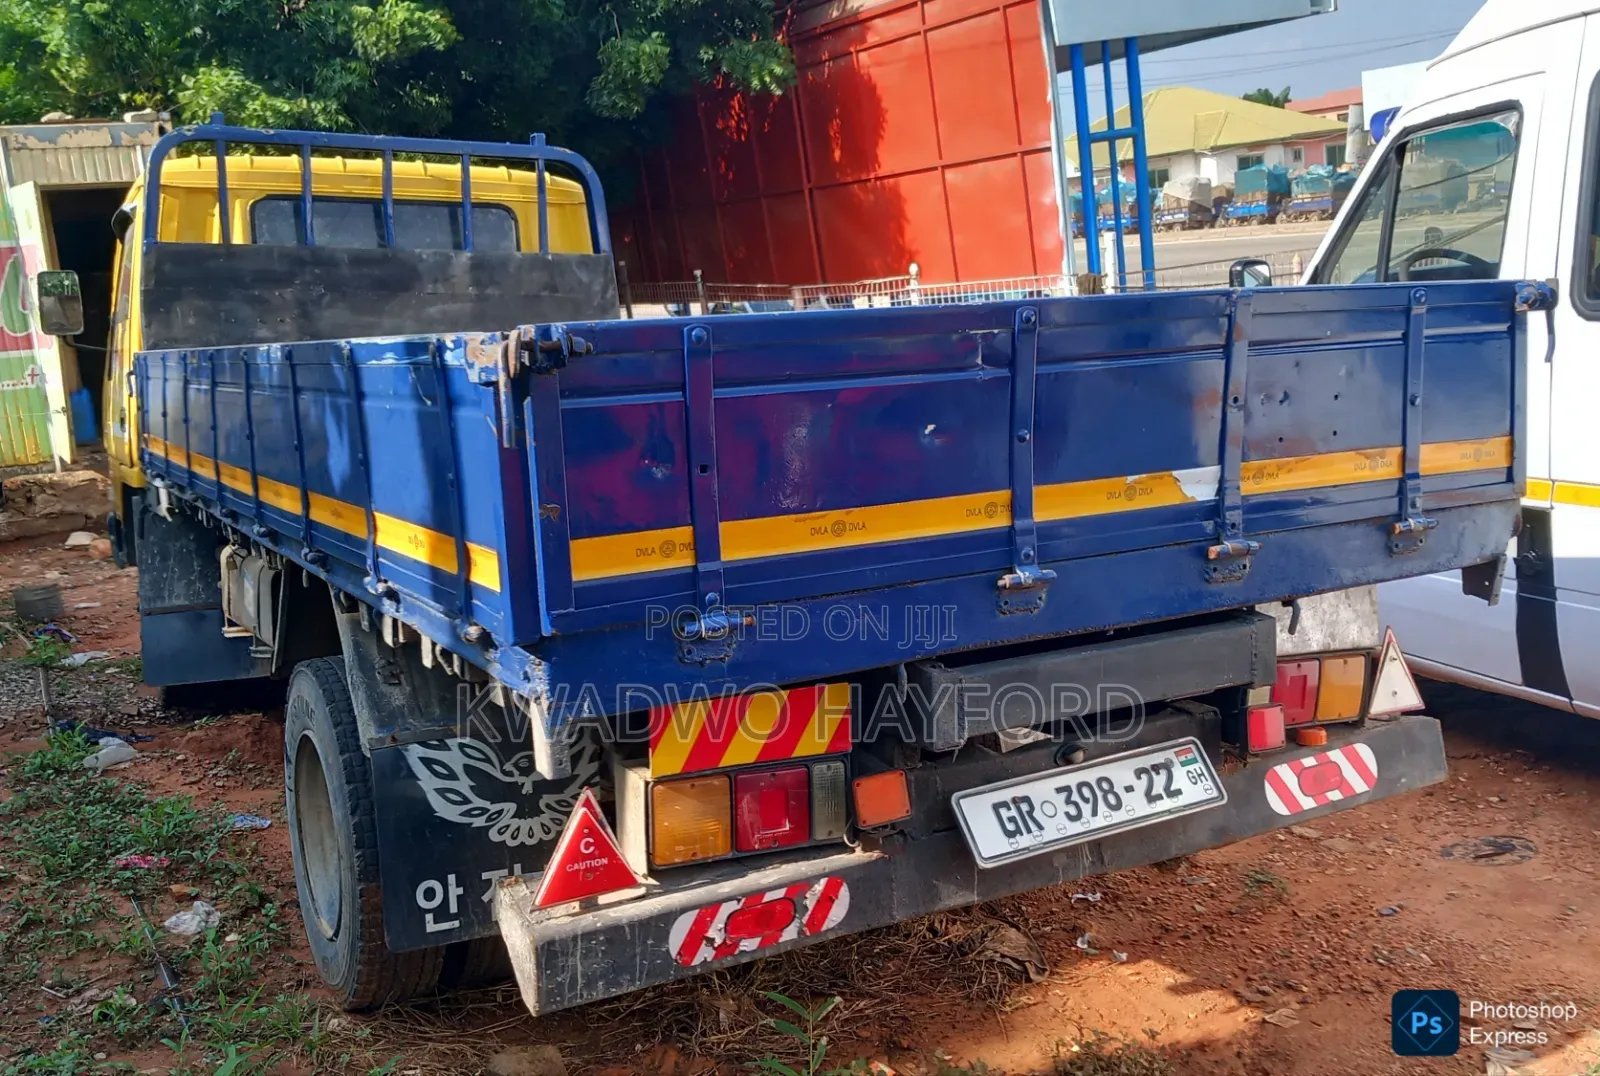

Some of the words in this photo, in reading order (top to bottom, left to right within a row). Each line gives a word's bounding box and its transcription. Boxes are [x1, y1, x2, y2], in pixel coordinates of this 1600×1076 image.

[810, 526, 828, 537] DVLA
[848, 521, 867, 532] DVLA
[635, 546, 656, 558] DVLA
[1186, 766, 1208, 786] GH
[992, 795, 1045, 839] GR
[1054, 763, 1183, 823] 398-22
[580, 837, 595, 854] C
[566, 857, 608, 872] CAUTION
